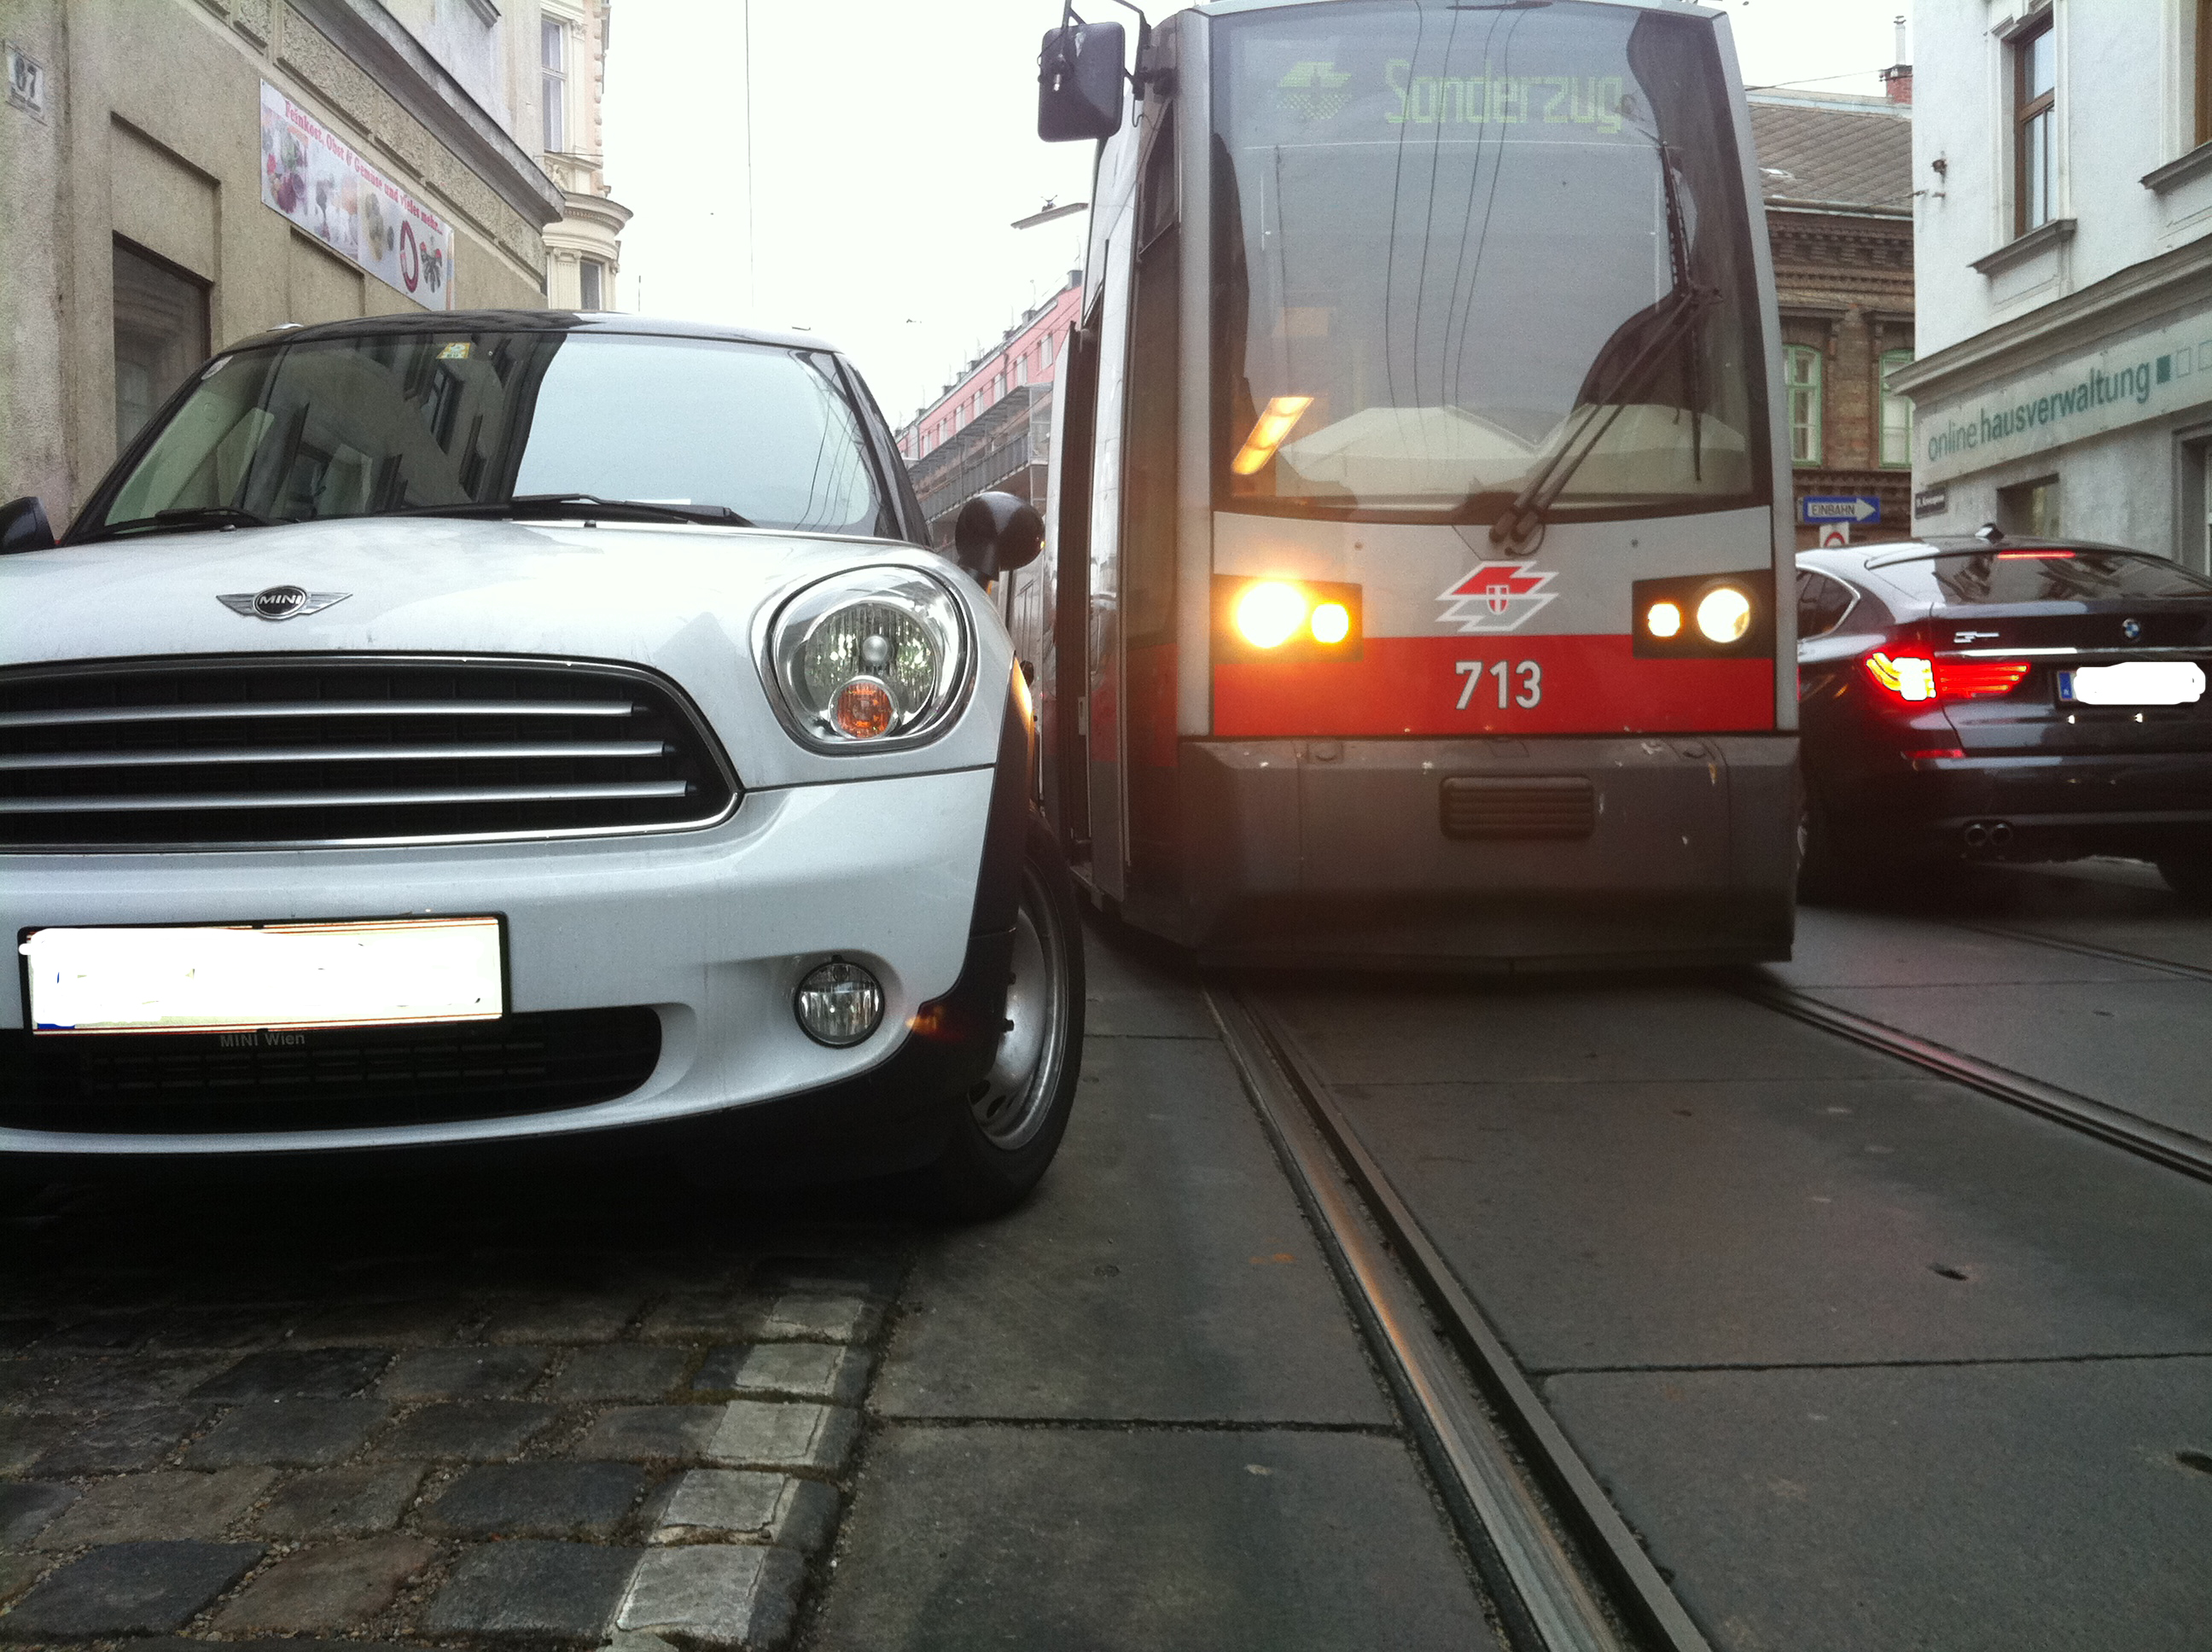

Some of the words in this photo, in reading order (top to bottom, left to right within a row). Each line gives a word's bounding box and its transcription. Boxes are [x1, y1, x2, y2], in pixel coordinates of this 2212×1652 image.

[1384, 58, 1622, 134] Sonderzug
[284, 100, 325, 146] Feinkost,
[326, 133, 345, 160] Obst
[384, 183, 399, 203] und
[400, 194, 420, 218] vieles
[1927, 419, 1977, 462] online
[1980, 362, 2151, 445] hausverwaltung
[1811, 504, 1855, 515] EINBAHN
[259, 594, 303, 606] MINI
[1455, 659, 1542, 710] 713
[220, 1032, 259, 1047] MINI
[265, 1032, 306, 1046] Wien
